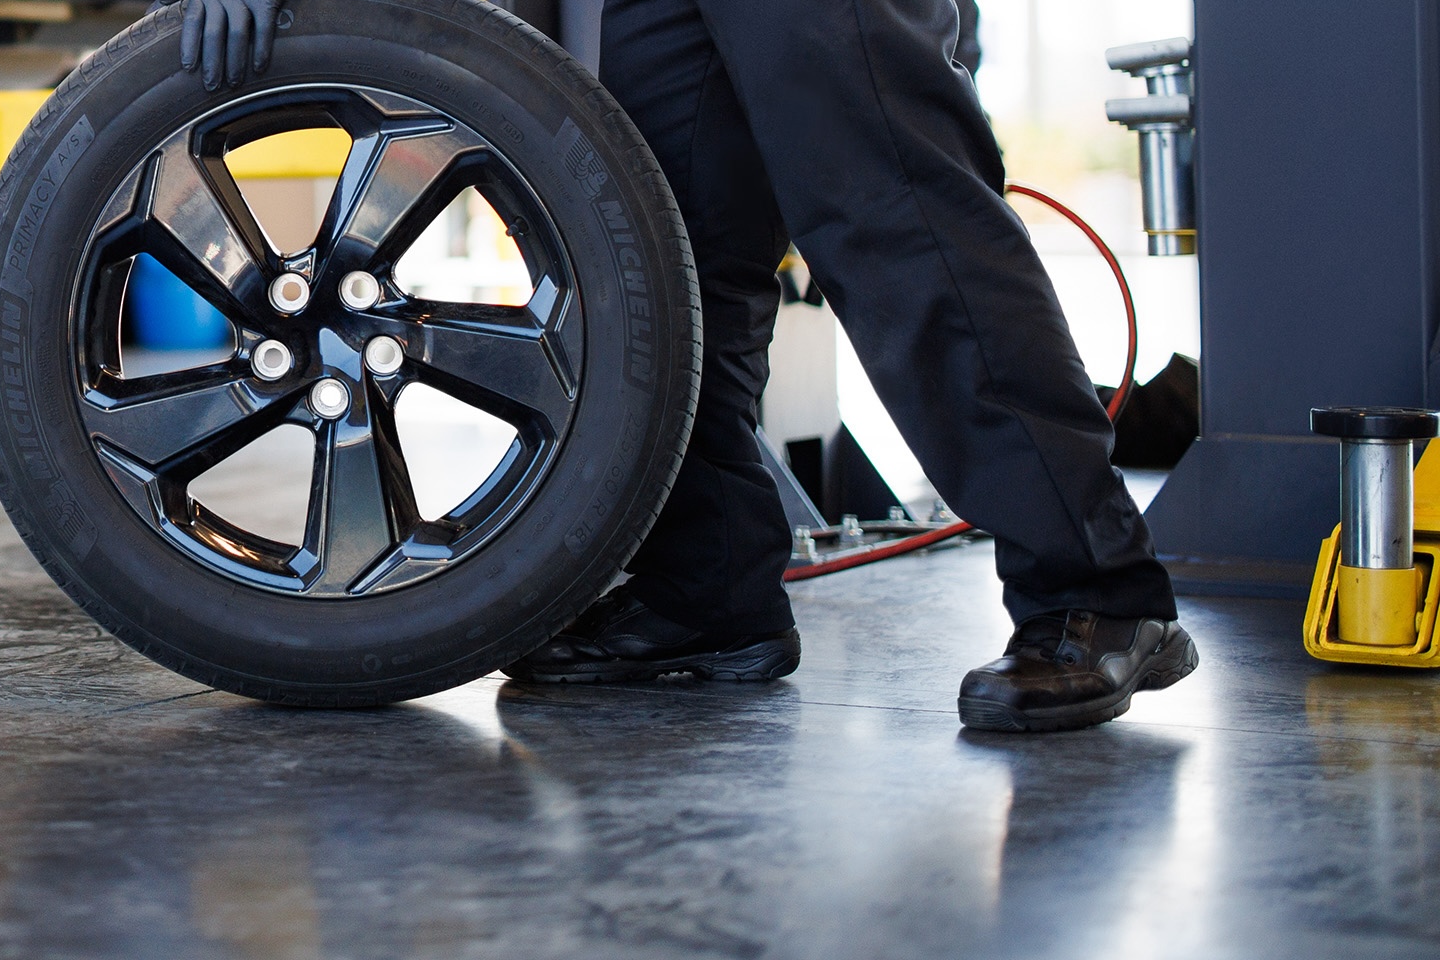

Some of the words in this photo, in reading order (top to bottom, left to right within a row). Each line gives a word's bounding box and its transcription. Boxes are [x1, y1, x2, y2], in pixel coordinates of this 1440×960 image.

[58, 134, 80, 167] A/S
[10, 170, 56, 271] PRIMACY
[599, 200, 653, 383] MICHELIN
[1, 301, 53, 480] MICHELIN
[605, 412, 644, 495] 225/60
[574, 521, 594, 544] 18
[592, 498, 608, 517] R
